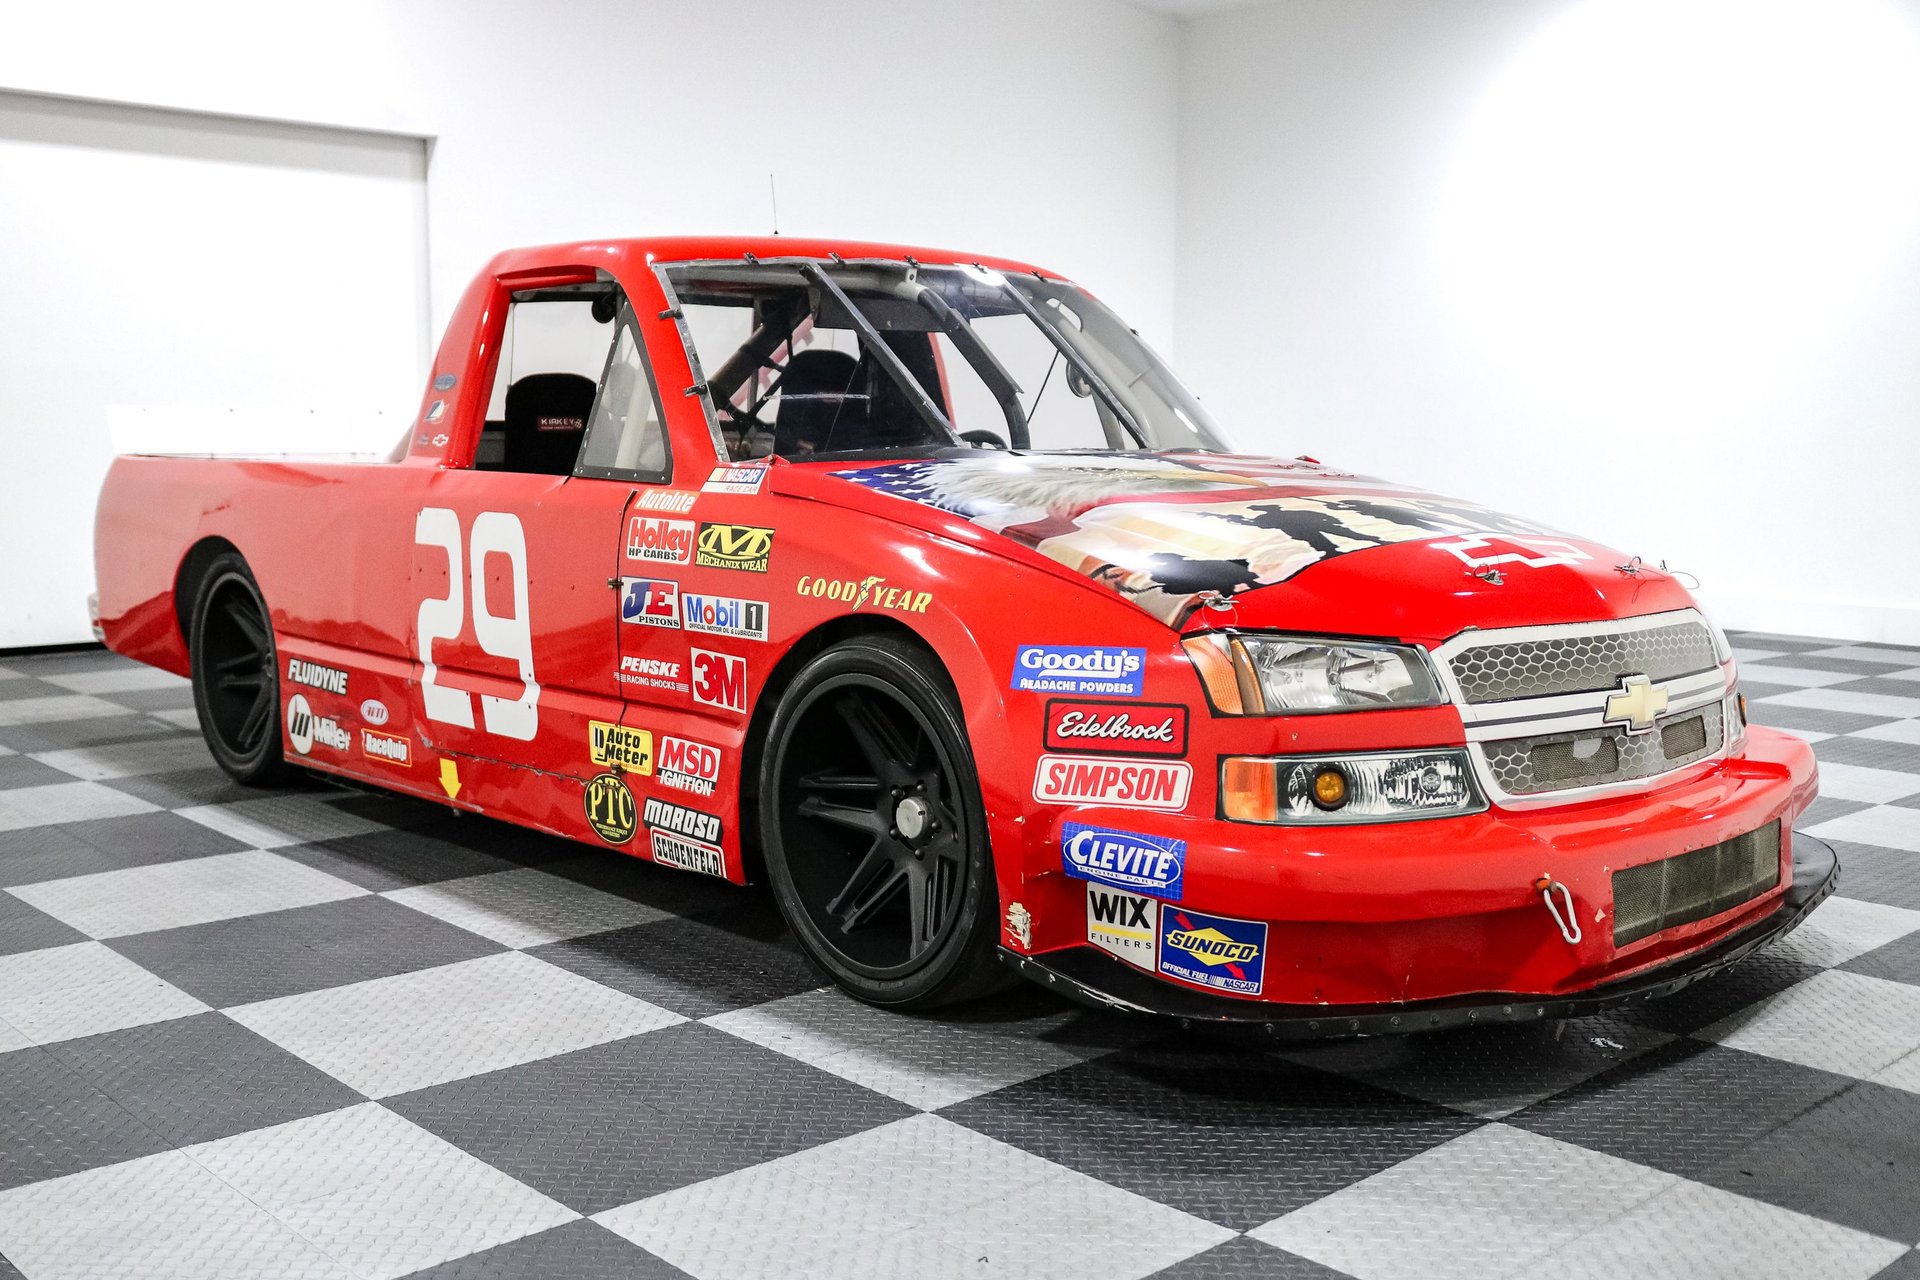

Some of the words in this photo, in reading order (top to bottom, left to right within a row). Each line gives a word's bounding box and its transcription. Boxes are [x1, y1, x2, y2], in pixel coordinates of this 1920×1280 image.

[726, 468, 760, 483] NASCAR
[636, 490, 696, 512] Autolite
[629, 519, 692, 561] Holley
[629, 547, 642, 557] HP
[643, 549, 677, 561] CARBS
[695, 551, 741, 569] MECHANIX
[741, 558, 768, 572] WEAR
[623, 581, 675, 619] JE
[797, 576, 858, 602] GOOD
[872, 586, 933, 613] YEAR
[415, 507, 541, 742] 29
[639, 616, 680, 628] PISTONS
[686, 596, 739, 628] Mobil
[689, 622, 706, 631] OFFICIAL
[734, 630, 762, 639] LUBRICANTS
[288, 658, 348, 695] FLUIDYNE
[620, 656, 680, 678] PENSKE
[1020, 649, 1140, 679] Goody's
[627, 675, 649, 687] RACING
[650, 677, 676, 690] SHOCKS
[694, 652, 745, 711] 3M
[1020, 678, 1076, 691] HEADACHE
[1079, 681, 1133, 693] POWDERS
[313, 715, 351, 751] Miller
[607, 728, 640, 749] Auto
[1056, 711, 1174, 743] Edelbrock
[365, 734, 408, 762] RaceQuip
[606, 744, 648, 766] Meter
[662, 739, 716, 779] MSD
[659, 769, 714, 797] IGNITION
[1045, 763, 1178, 801] SIMPSON
[589, 777, 634, 830] PTC
[643, 799, 720, 842] MOROSO
[655, 836, 719, 875] SCHOENFELD
[1070, 830, 1174, 880] CLEVITE
[1080, 866, 1120, 878] ENGINE
[1126, 875, 1164, 887] PARTS
[1089, 891, 1152, 929] WIX
[1091, 932, 1152, 950] FILTERS
[1170, 932, 1253, 960] SUNOCO
[1162, 961, 1190, 977] OFFICIAL
[1191, 970, 1209, 982] FUEL
[1223, 979, 1257, 992] NASCAR
